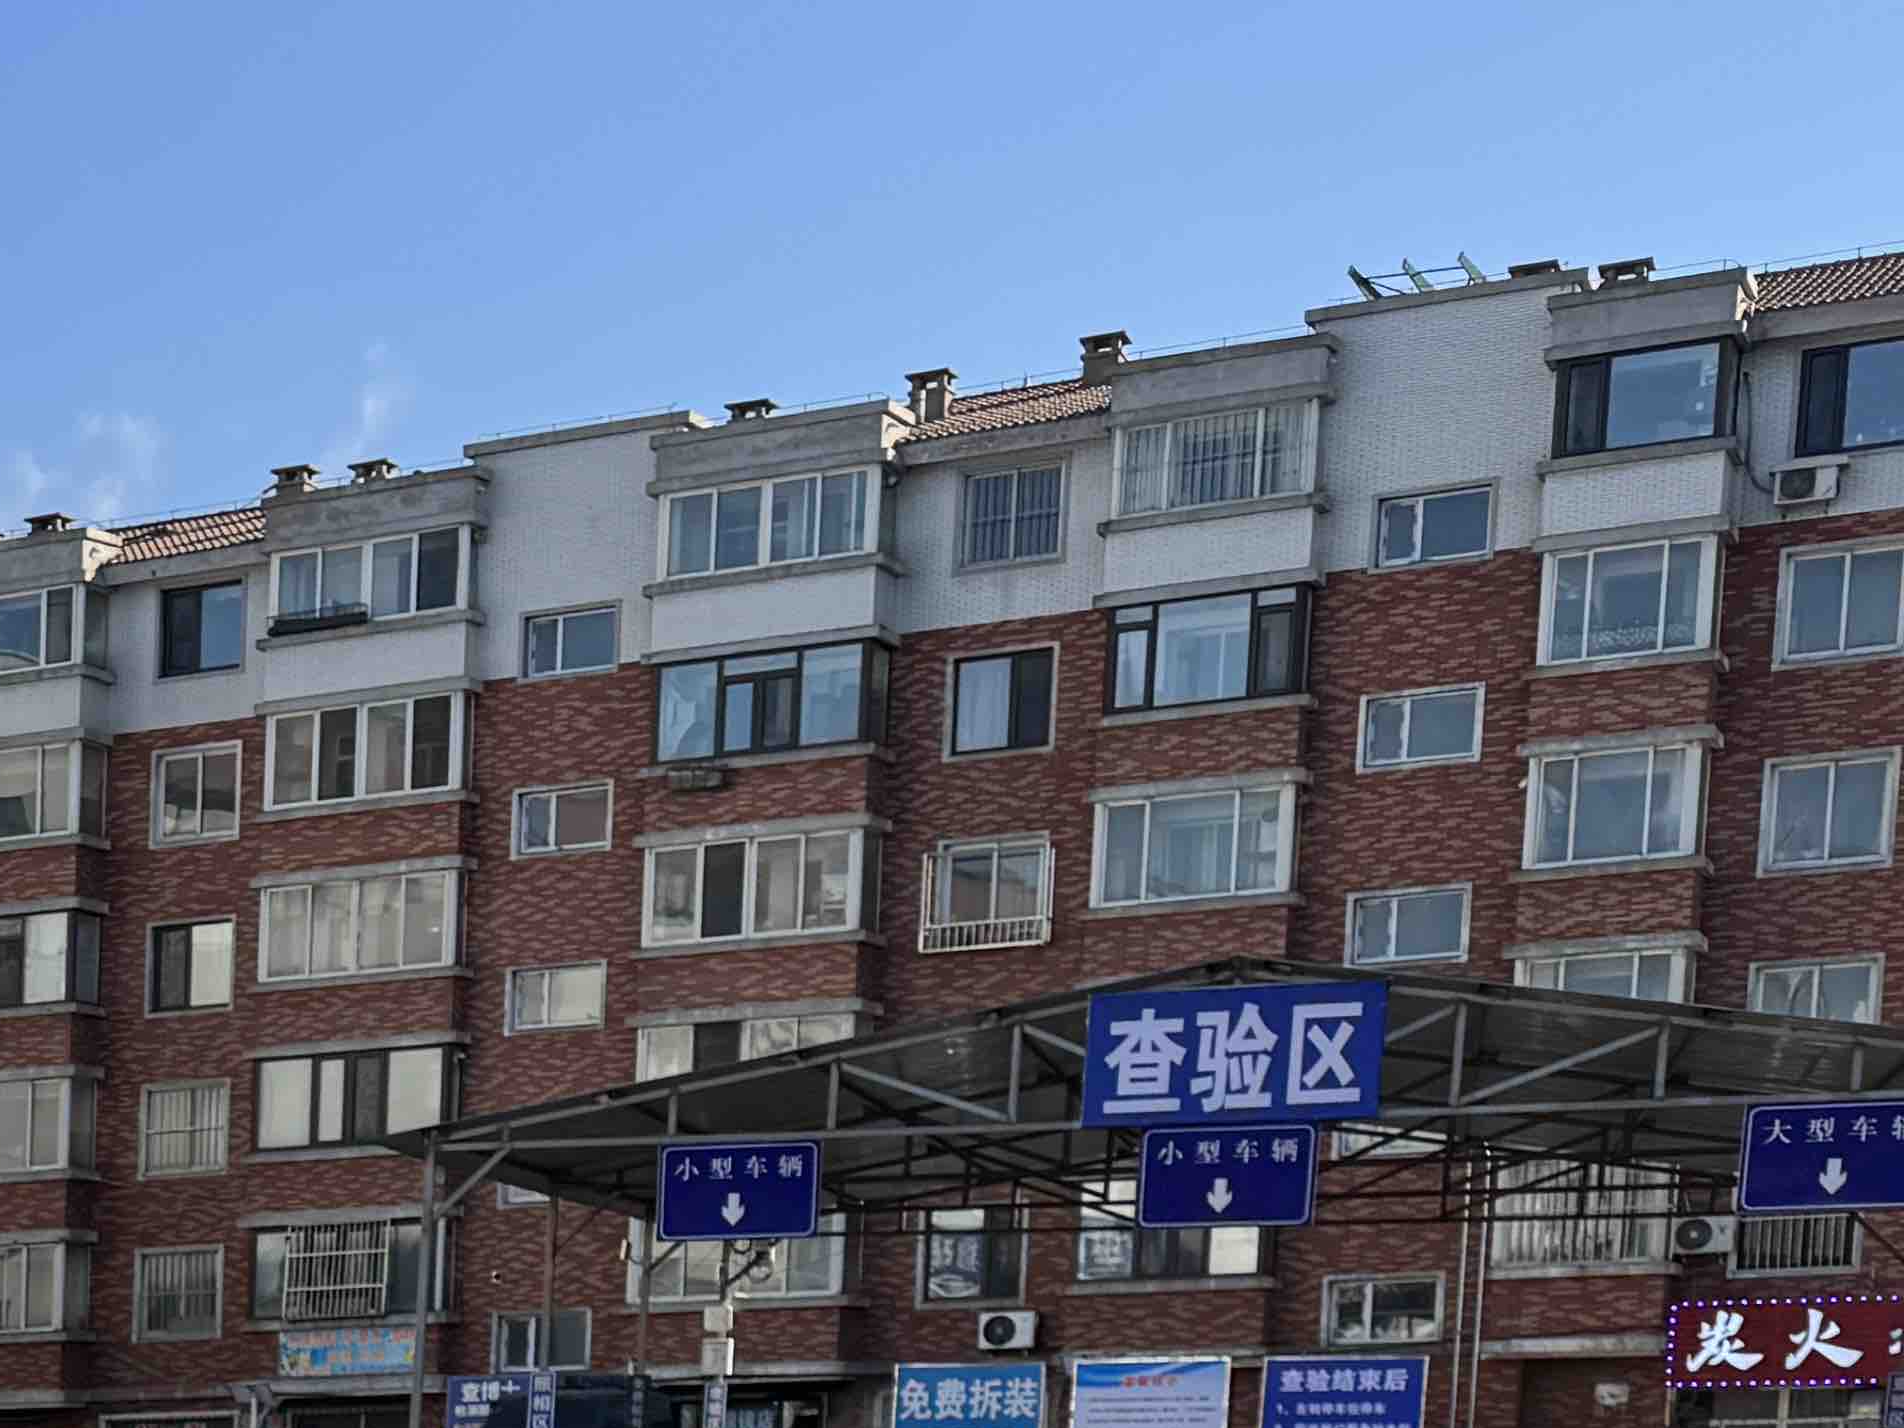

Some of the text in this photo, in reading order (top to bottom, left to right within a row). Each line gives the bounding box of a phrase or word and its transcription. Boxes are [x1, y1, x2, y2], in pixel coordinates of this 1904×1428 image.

[1101, 1001, 1365, 1114] 查验区
[673, 1153, 803, 1182] 小型车辆
[1157, 1137, 1299, 1166] 小型车辆
[1686, 1308, 1904, 1372] 炭火
[900, 1377, 1039, 1420] 免费拆装
[1280, 1368, 1409, 1393] 查验结束后
